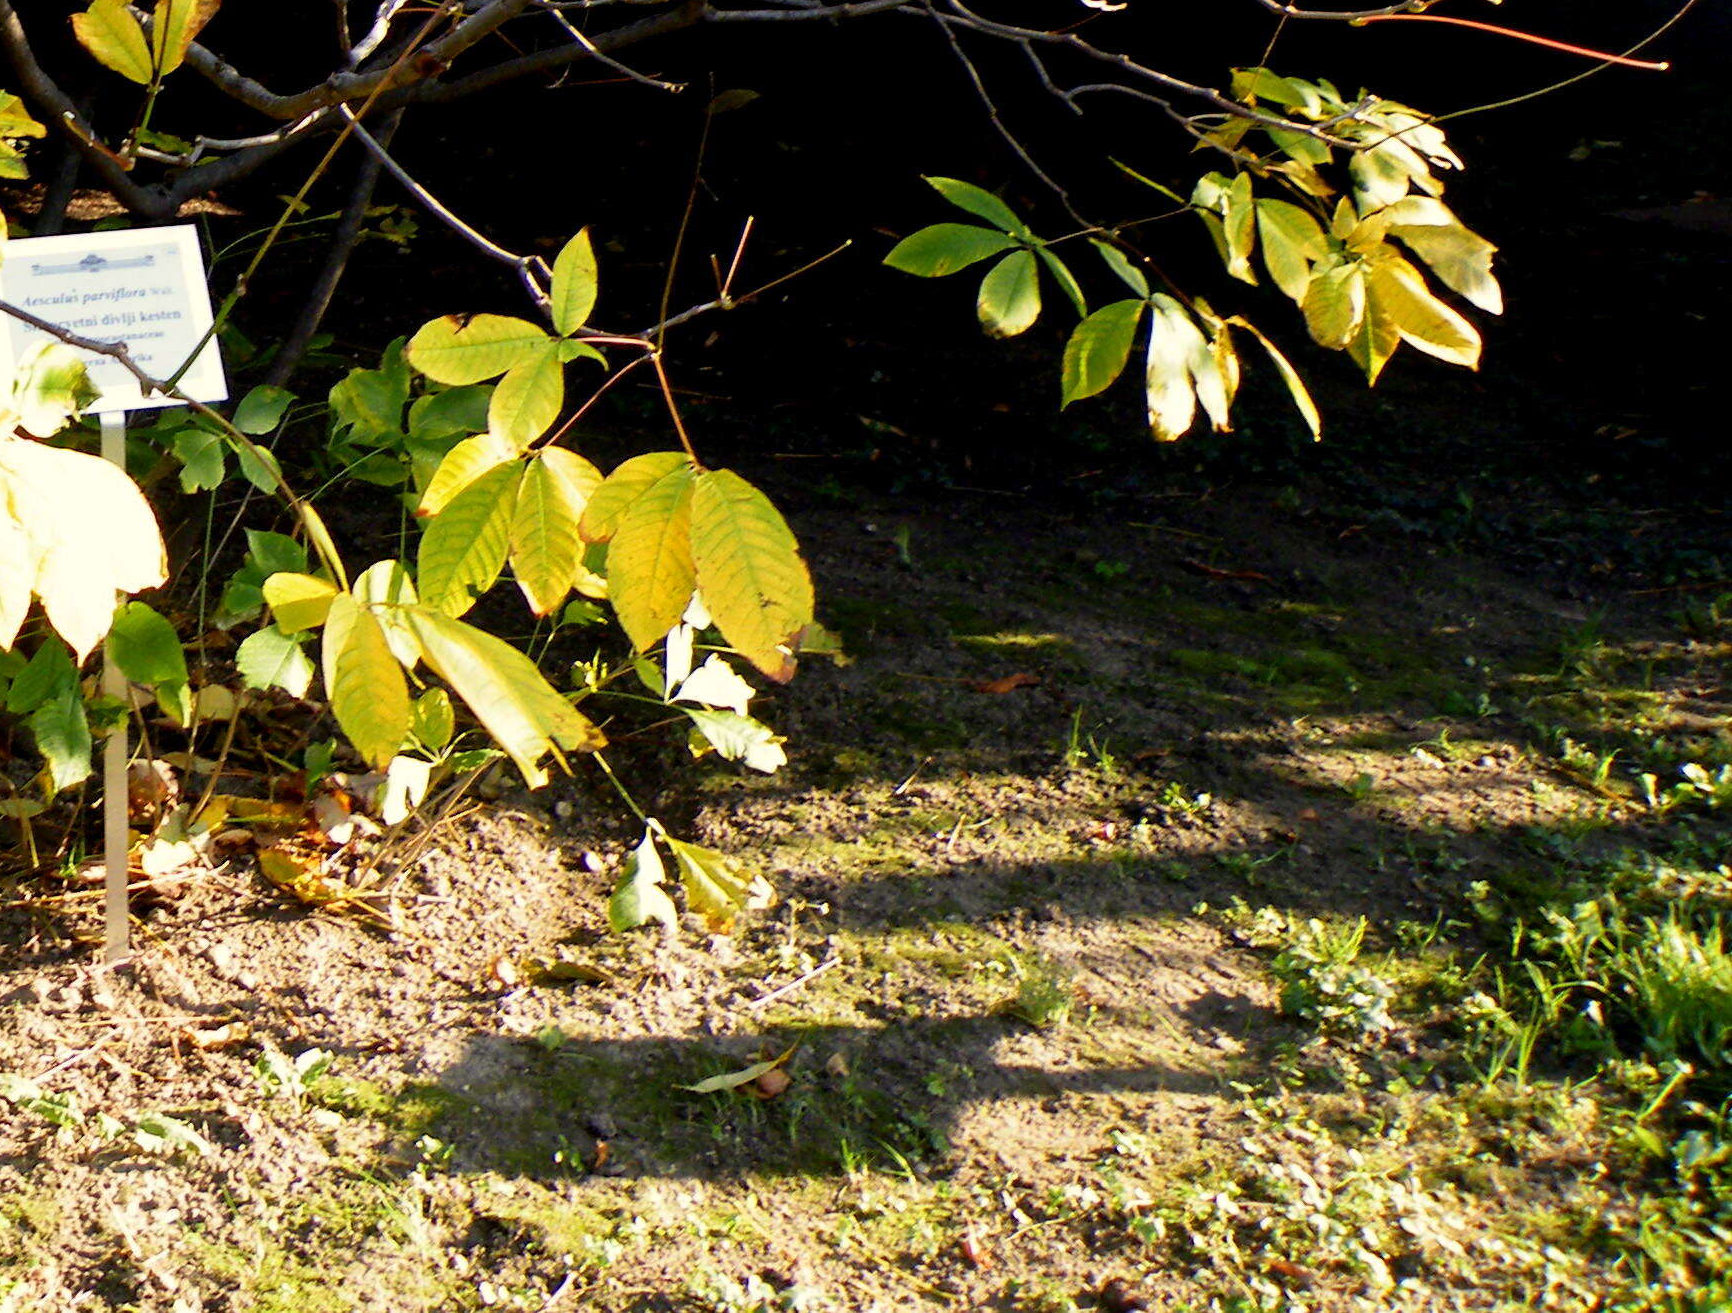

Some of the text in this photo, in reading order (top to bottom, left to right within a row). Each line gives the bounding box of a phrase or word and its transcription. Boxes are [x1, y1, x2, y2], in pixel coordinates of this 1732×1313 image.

[22, 291, 79, 307] Aesculus
[82, 287, 146, 304] parviflora
[101, 311, 136, 327] divlji
[140, 309, 182, 322] kesten
